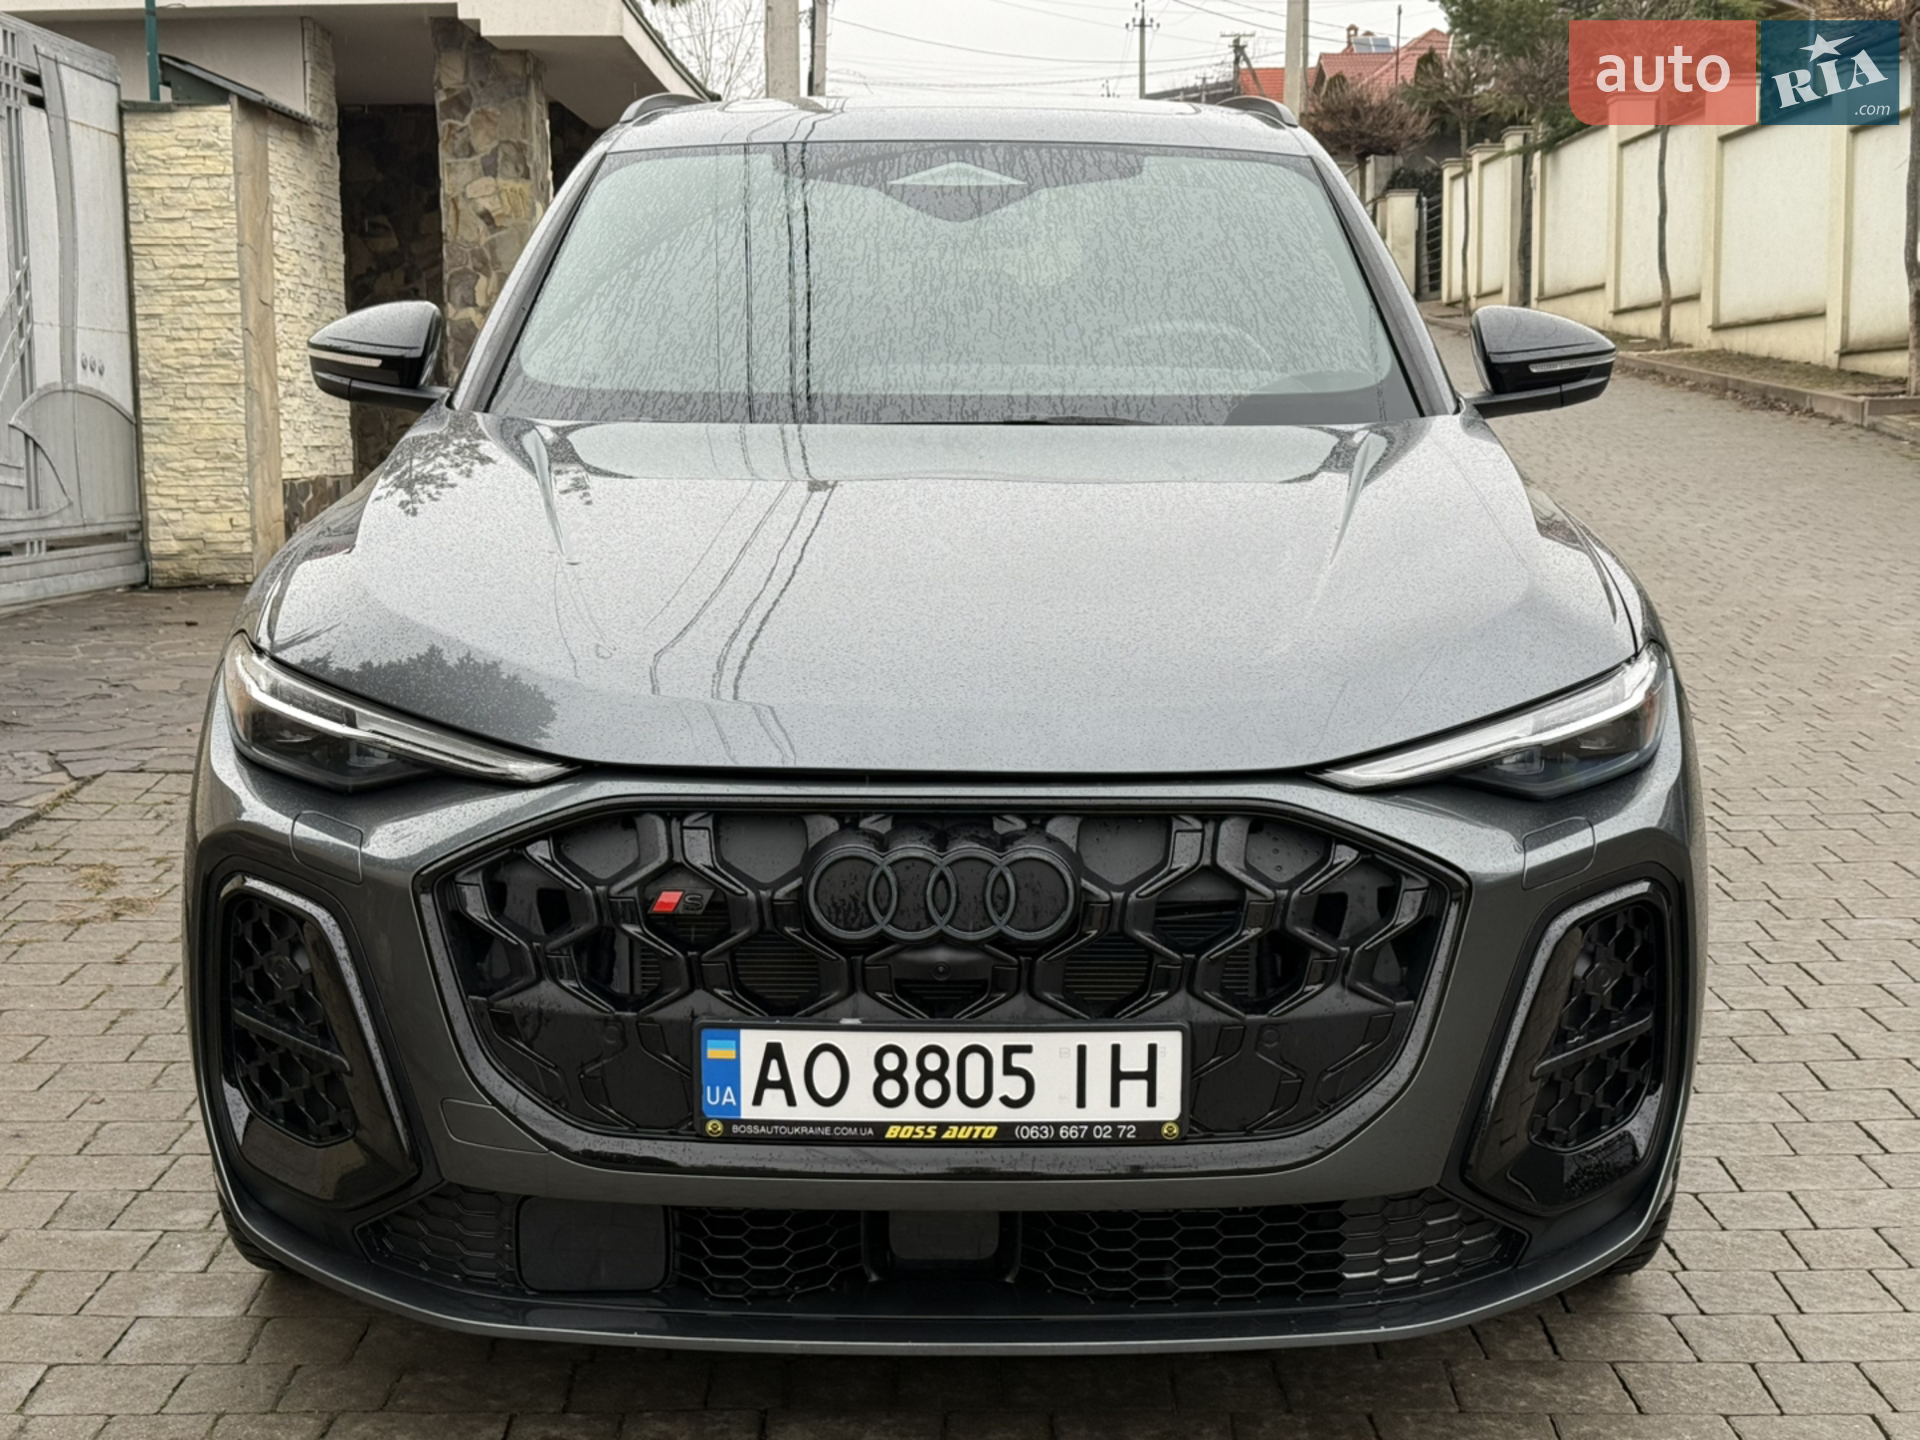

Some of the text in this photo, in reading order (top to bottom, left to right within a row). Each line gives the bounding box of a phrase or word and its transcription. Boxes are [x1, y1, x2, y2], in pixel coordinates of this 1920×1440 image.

[751, 1041, 1158, 1109] AO 8805 IH
[706, 1085, 737, 1107] UA
[731, 1124, 1137, 1140] BOSSAUTOUKRAINE.COM.UA BOSS AUTO (063) 667 02 72
